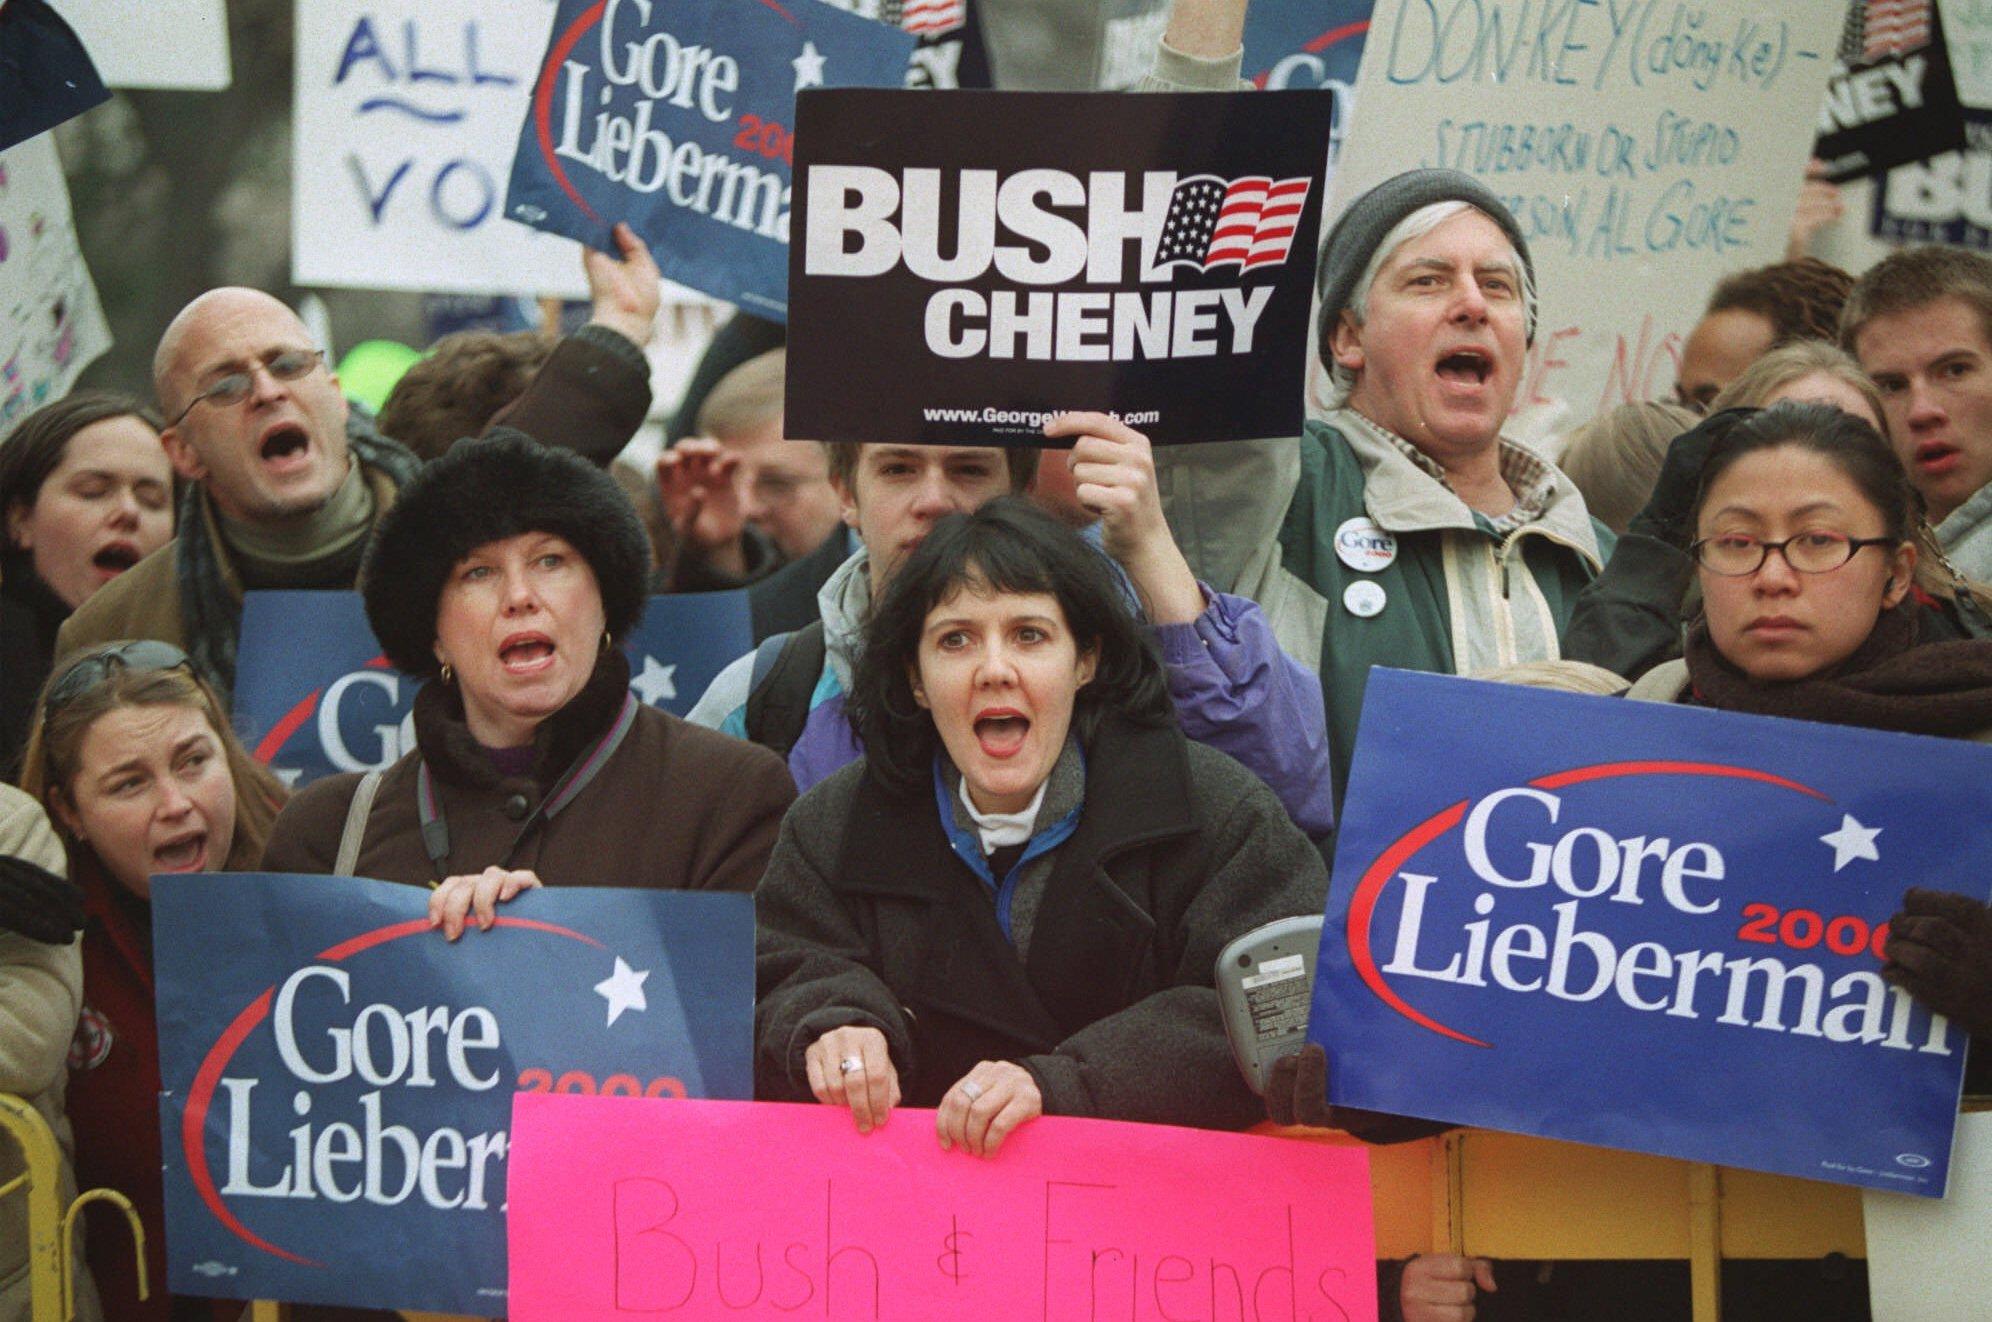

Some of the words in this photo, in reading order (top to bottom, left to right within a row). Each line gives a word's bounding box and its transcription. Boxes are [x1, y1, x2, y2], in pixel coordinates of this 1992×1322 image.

[333, 15, 517, 86] ALL
[601, 0, 740, 122] Gore
[553, 59, 793, 244] Lieberm
[733, 113, 793, 167] 20
[805, 165, 1180, 285] BUSH
[1644, 178, 1757, 255] GORE
[924, 285, 1275, 362] CHENEY
[1341, 530, 1393, 551] Gore
[1463, 786, 1725, 915] Gore
[1381, 872, 1952, 1056] Lieberman
[273, 965, 500, 1091] Gore
[220, 1077, 511, 1213] Lieber
[612, 1175, 880, 1318] Bush
[937, 1214, 973, 1287] &
[1044, 1180, 1351, 1322] Friends
